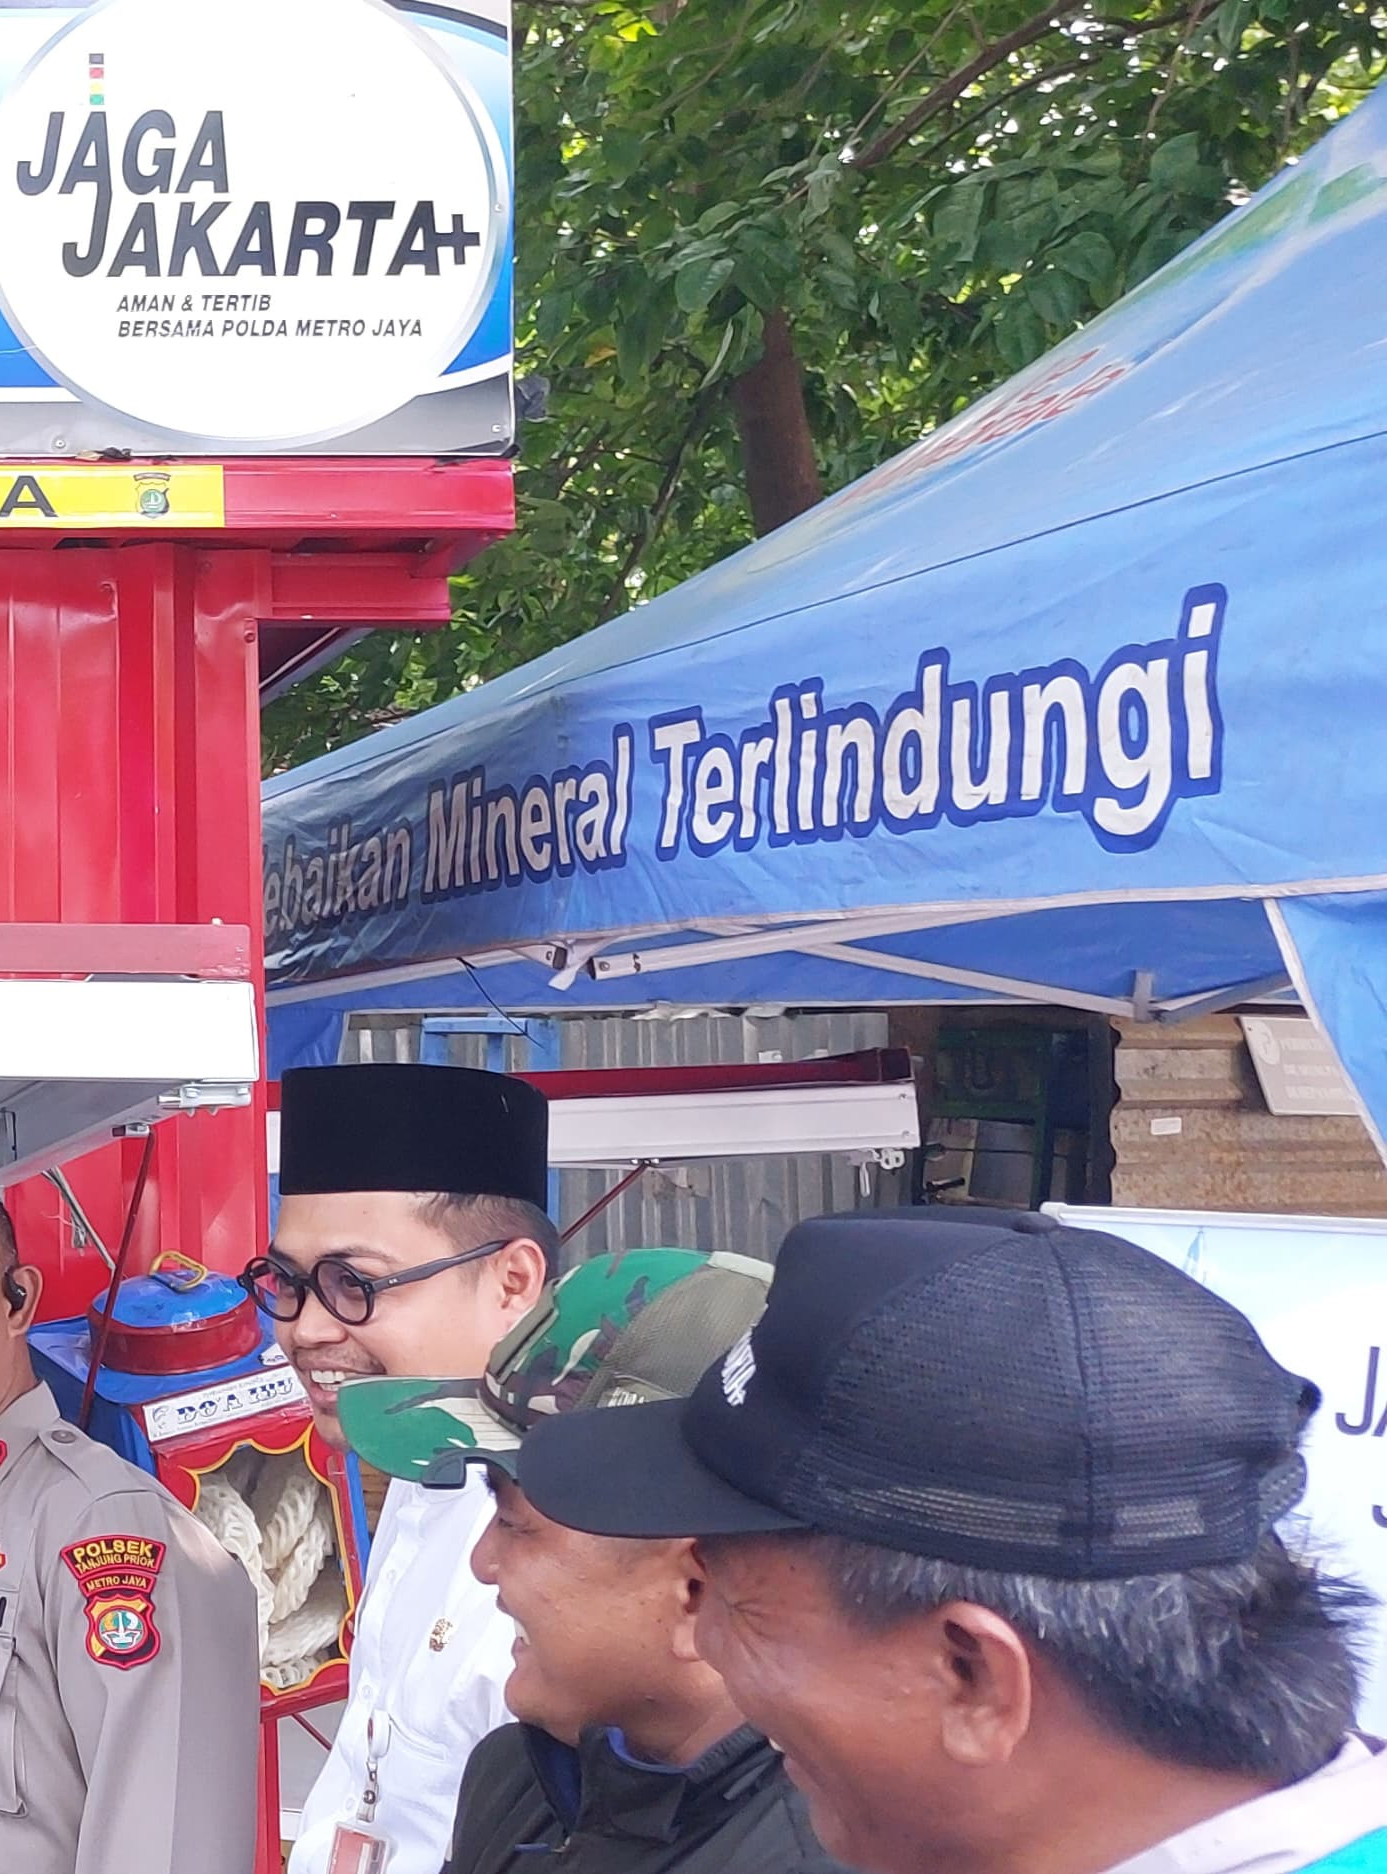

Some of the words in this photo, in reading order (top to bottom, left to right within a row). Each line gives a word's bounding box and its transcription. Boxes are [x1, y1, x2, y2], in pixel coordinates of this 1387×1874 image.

[16, 109, 229, 196] JAGA
[116, 294, 174, 312] AMAN
[182, 296, 193, 311] &
[202, 294, 271, 311] TERTIB
[118, 321, 214, 338] BERSAMA
[221, 321, 287, 338] POLDA
[295, 320, 365, 337] METRO
[372, 320, 423, 338] JAYA
[263, 824, 411, 937] ebaikan
[426, 735, 631, 888] Mineral
[654, 600, 1219, 856] Terlindungi
[73, 1539, 153, 1563] POLSEK
[75, 1553, 123, 1574] TANJUNG
[123, 1554, 155, 1568] PRIOK
[86, 1576, 121, 1592] METRO
[122, 1575, 147, 1588] JAYA
